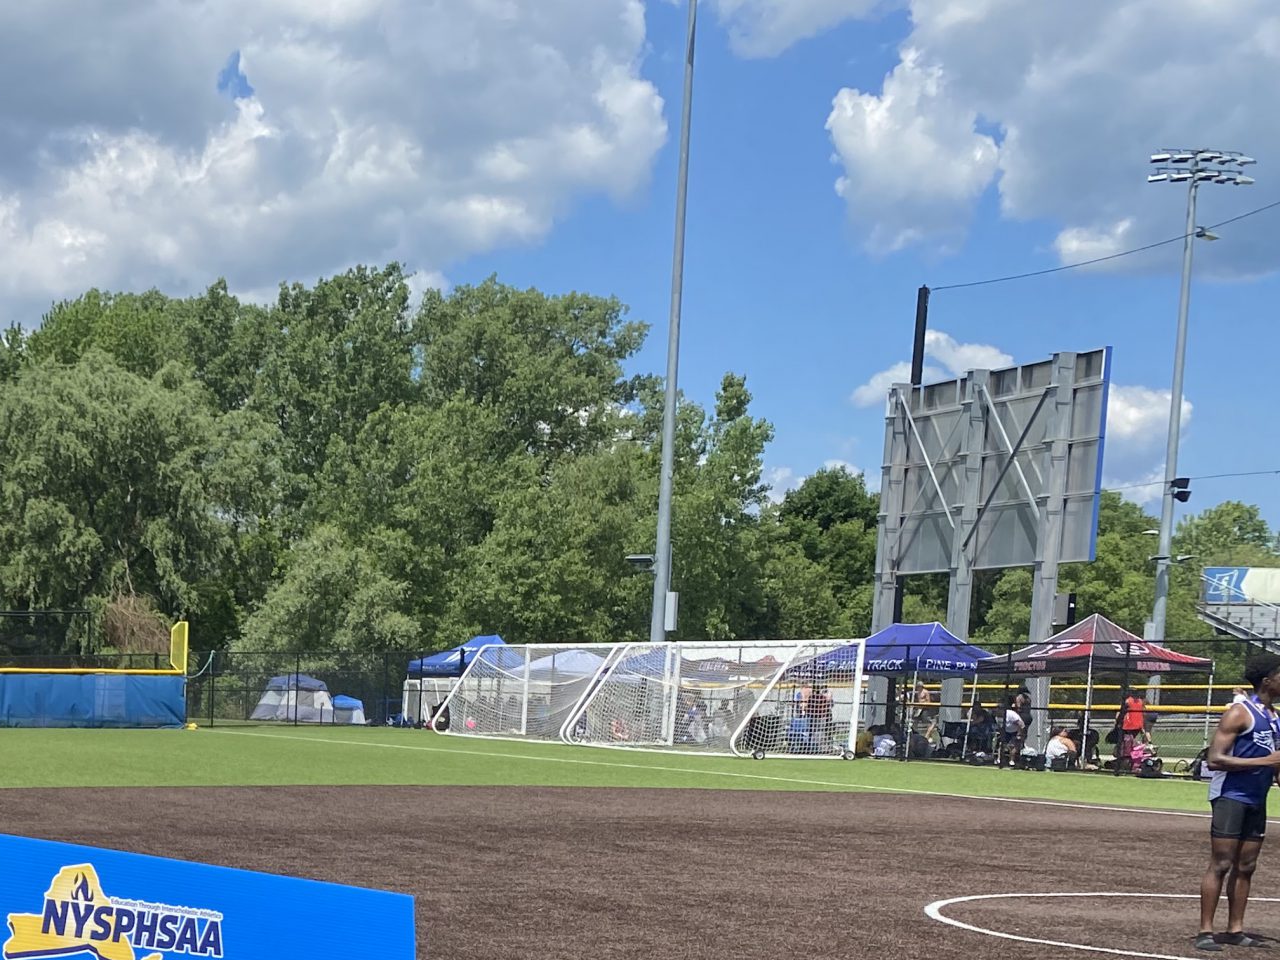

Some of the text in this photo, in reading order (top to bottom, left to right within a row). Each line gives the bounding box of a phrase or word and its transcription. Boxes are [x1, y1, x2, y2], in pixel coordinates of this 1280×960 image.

[867, 659, 905, 671] TRACK
[925, 659, 952, 670] PINE
[111, 898, 222, 920] Education Through Interscholastic Athletics
[41, 899, 222, 956] NYSPHSAA
